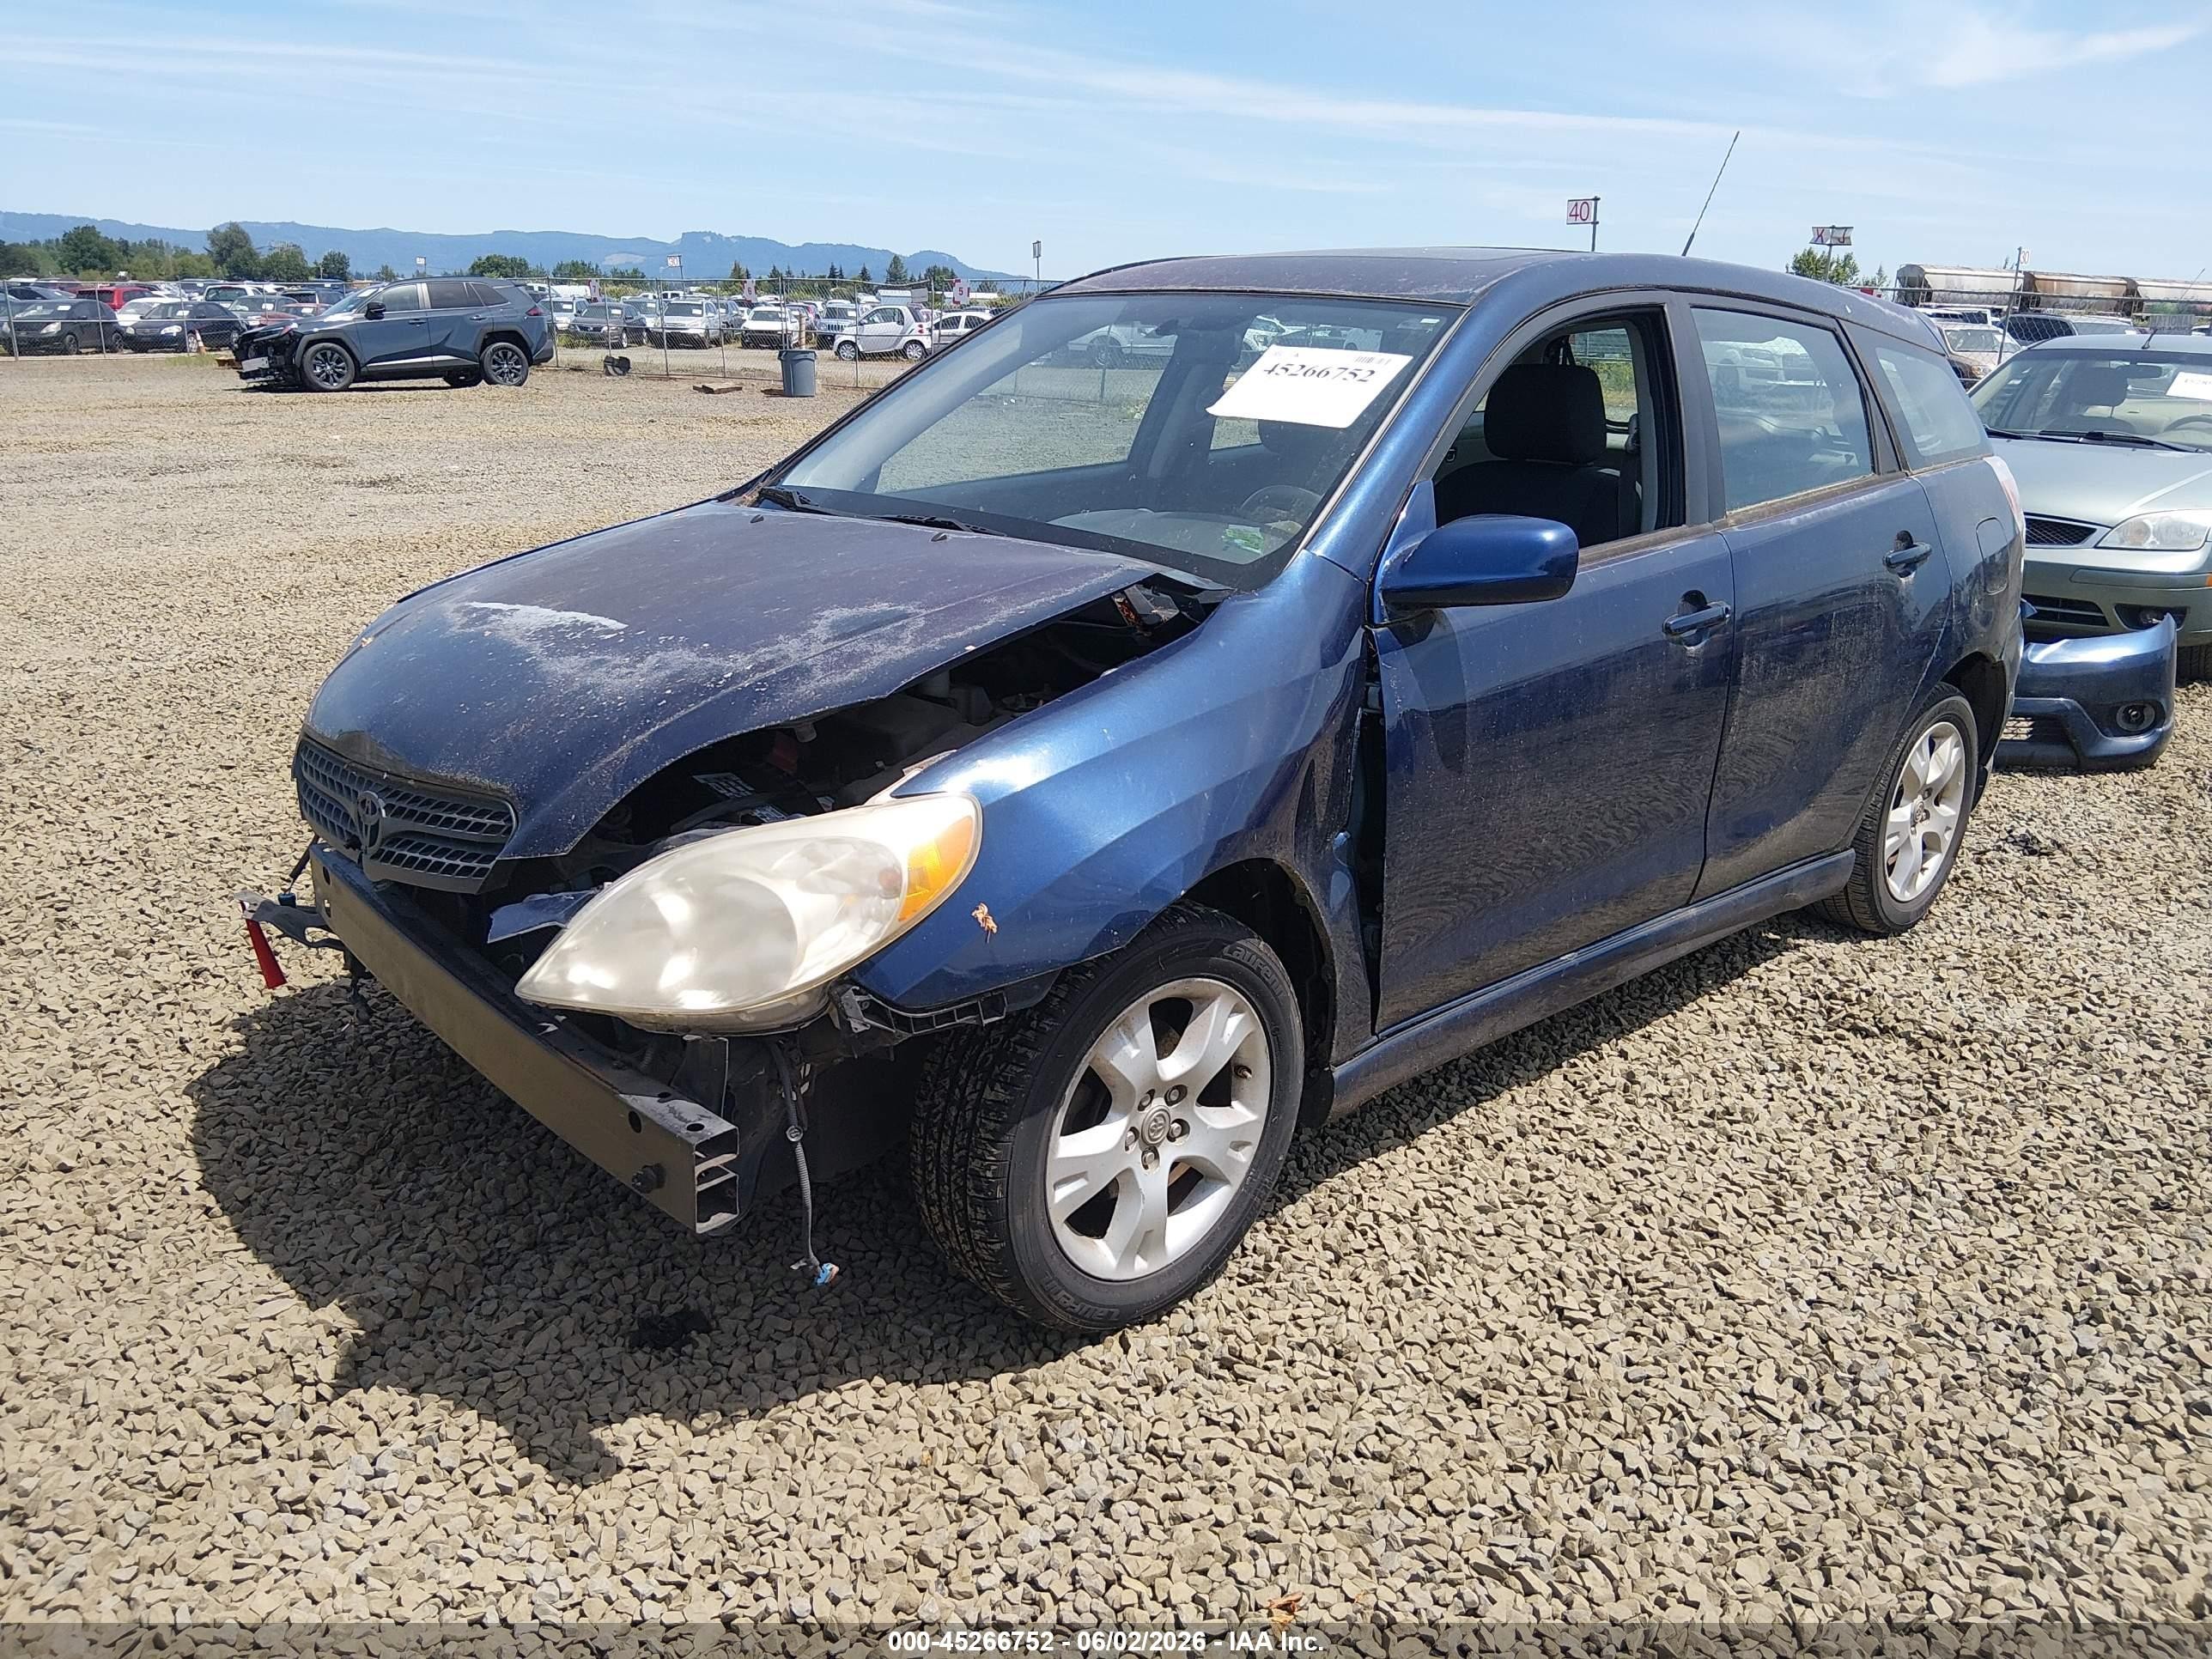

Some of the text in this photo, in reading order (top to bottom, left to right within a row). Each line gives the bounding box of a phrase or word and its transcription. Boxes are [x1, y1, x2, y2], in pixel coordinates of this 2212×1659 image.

[1569, 201, 1590, 222] 40
[1814, 228, 1826, 243] X
[1838, 228, 1848, 244] J
[958, 287, 963, 296] 5
[1264, 362, 1376, 382] 45266752
